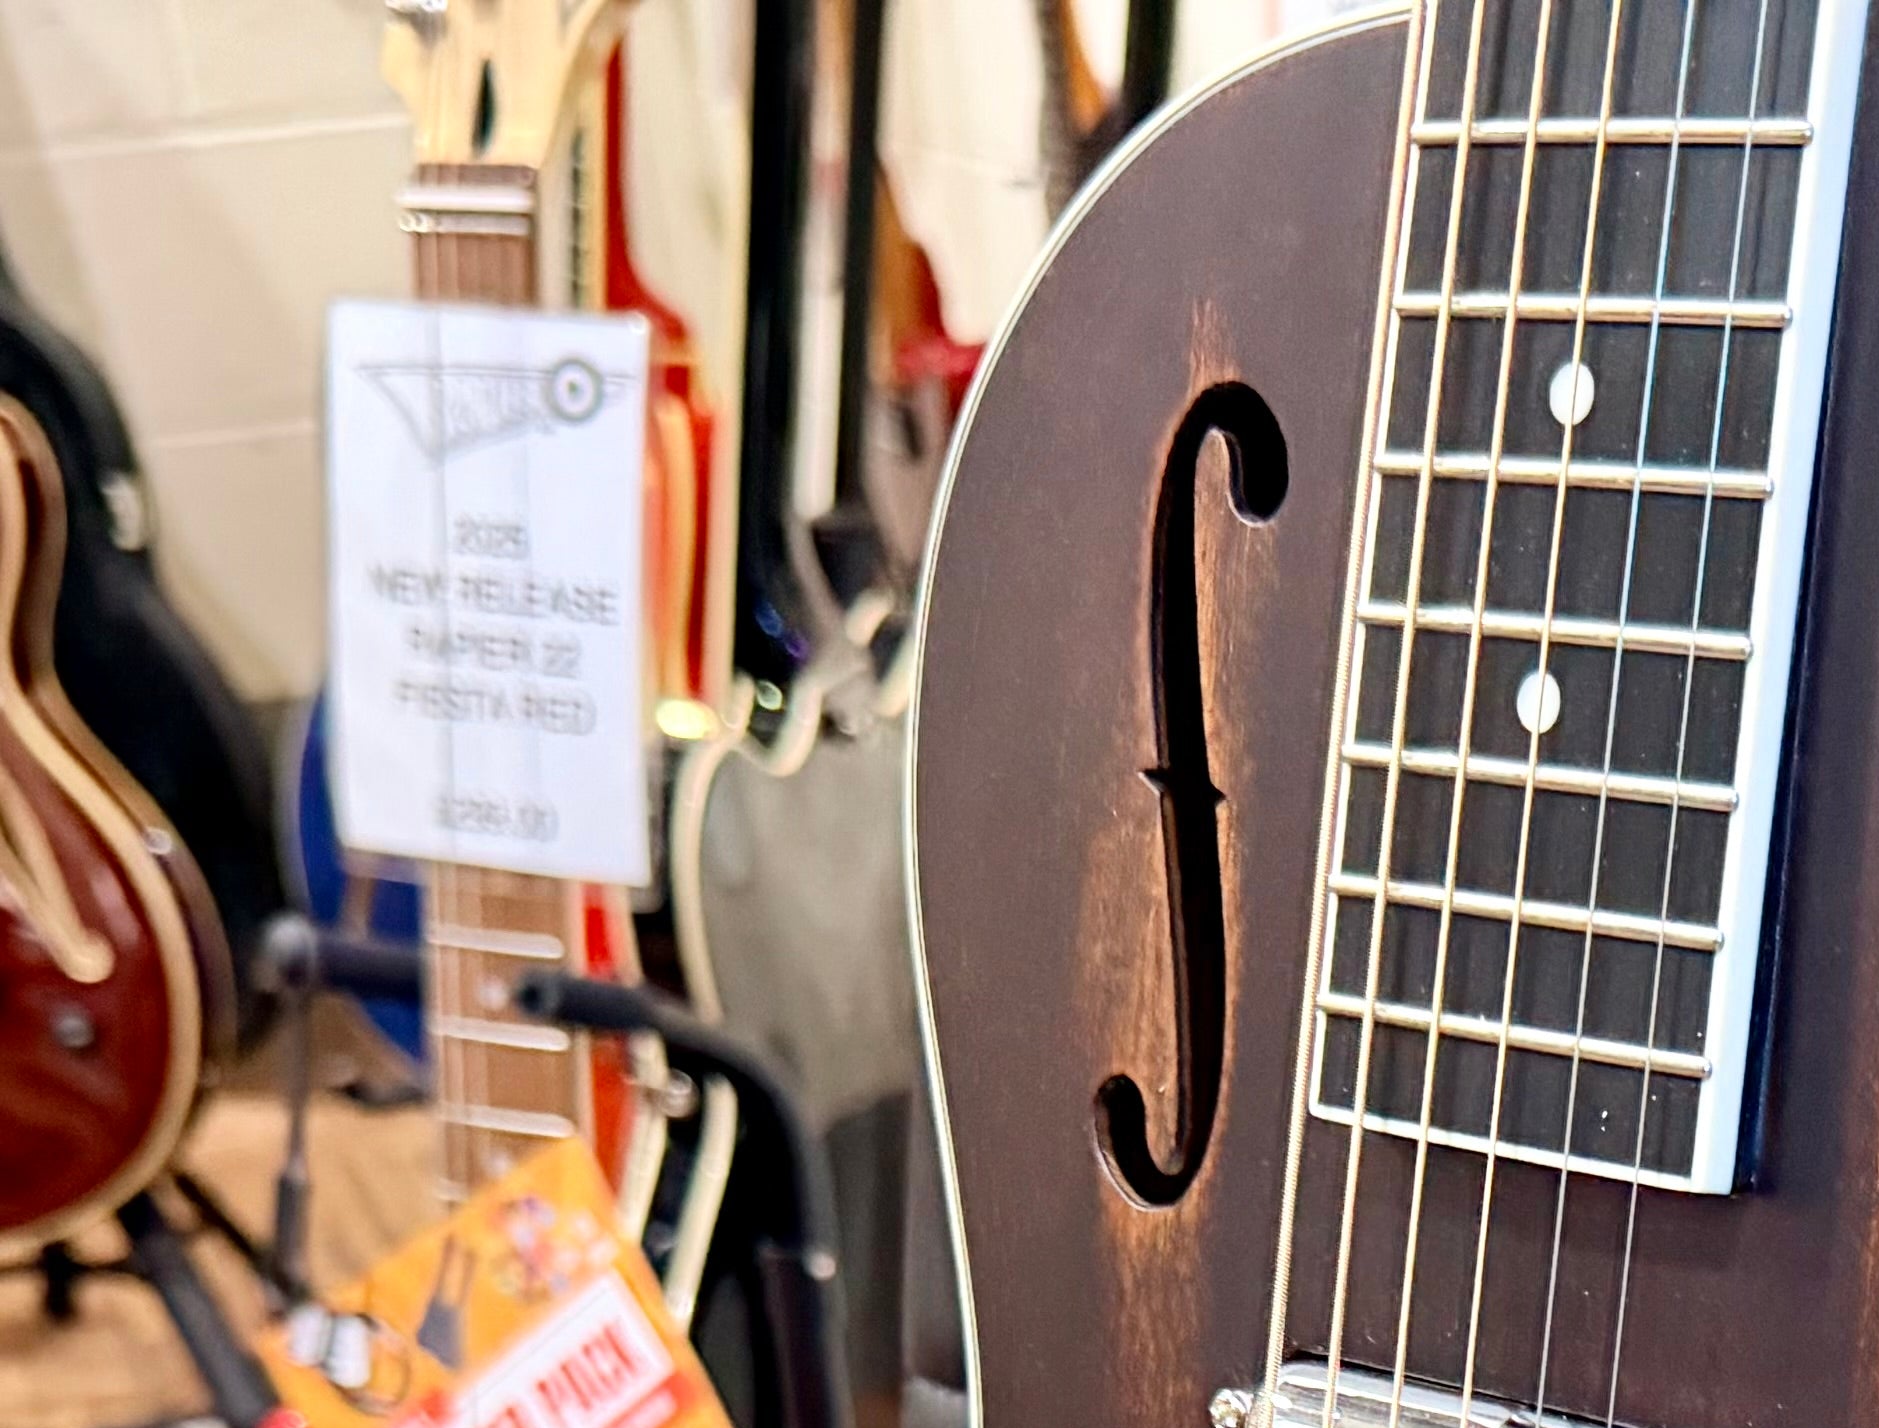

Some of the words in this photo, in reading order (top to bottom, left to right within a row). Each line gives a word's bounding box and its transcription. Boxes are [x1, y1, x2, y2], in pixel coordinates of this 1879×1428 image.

[367, 560, 446, 606] NEW
[456, 571, 620, 626] RELEASE
[395, 678, 512, 722] FIESTA
[521, 684, 598, 737] RED
